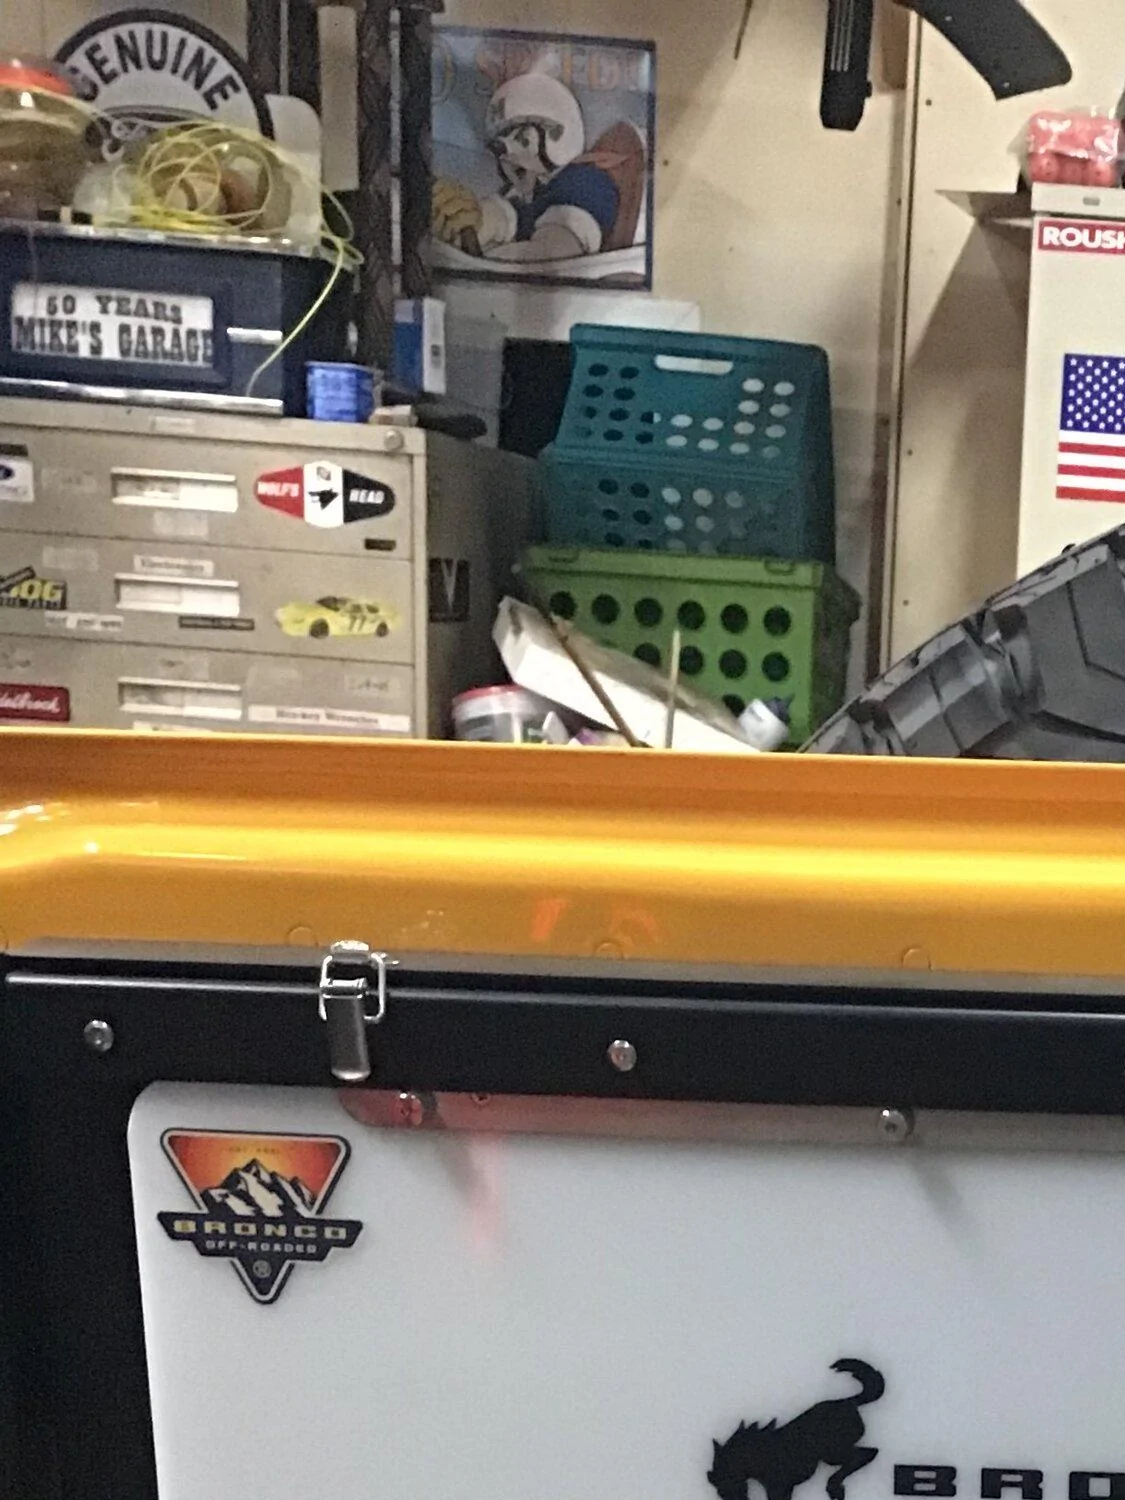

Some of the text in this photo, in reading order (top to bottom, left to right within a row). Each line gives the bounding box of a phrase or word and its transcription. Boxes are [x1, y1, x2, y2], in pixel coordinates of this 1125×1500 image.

[68, 30, 241, 110] GENUINE
[96, 296, 182, 325] YEARS
[14, 316, 213, 363] MIKE'S GARAGE
[349, 488, 385, 504] HEAD
[173, 1220, 347, 1240] BRONCO
